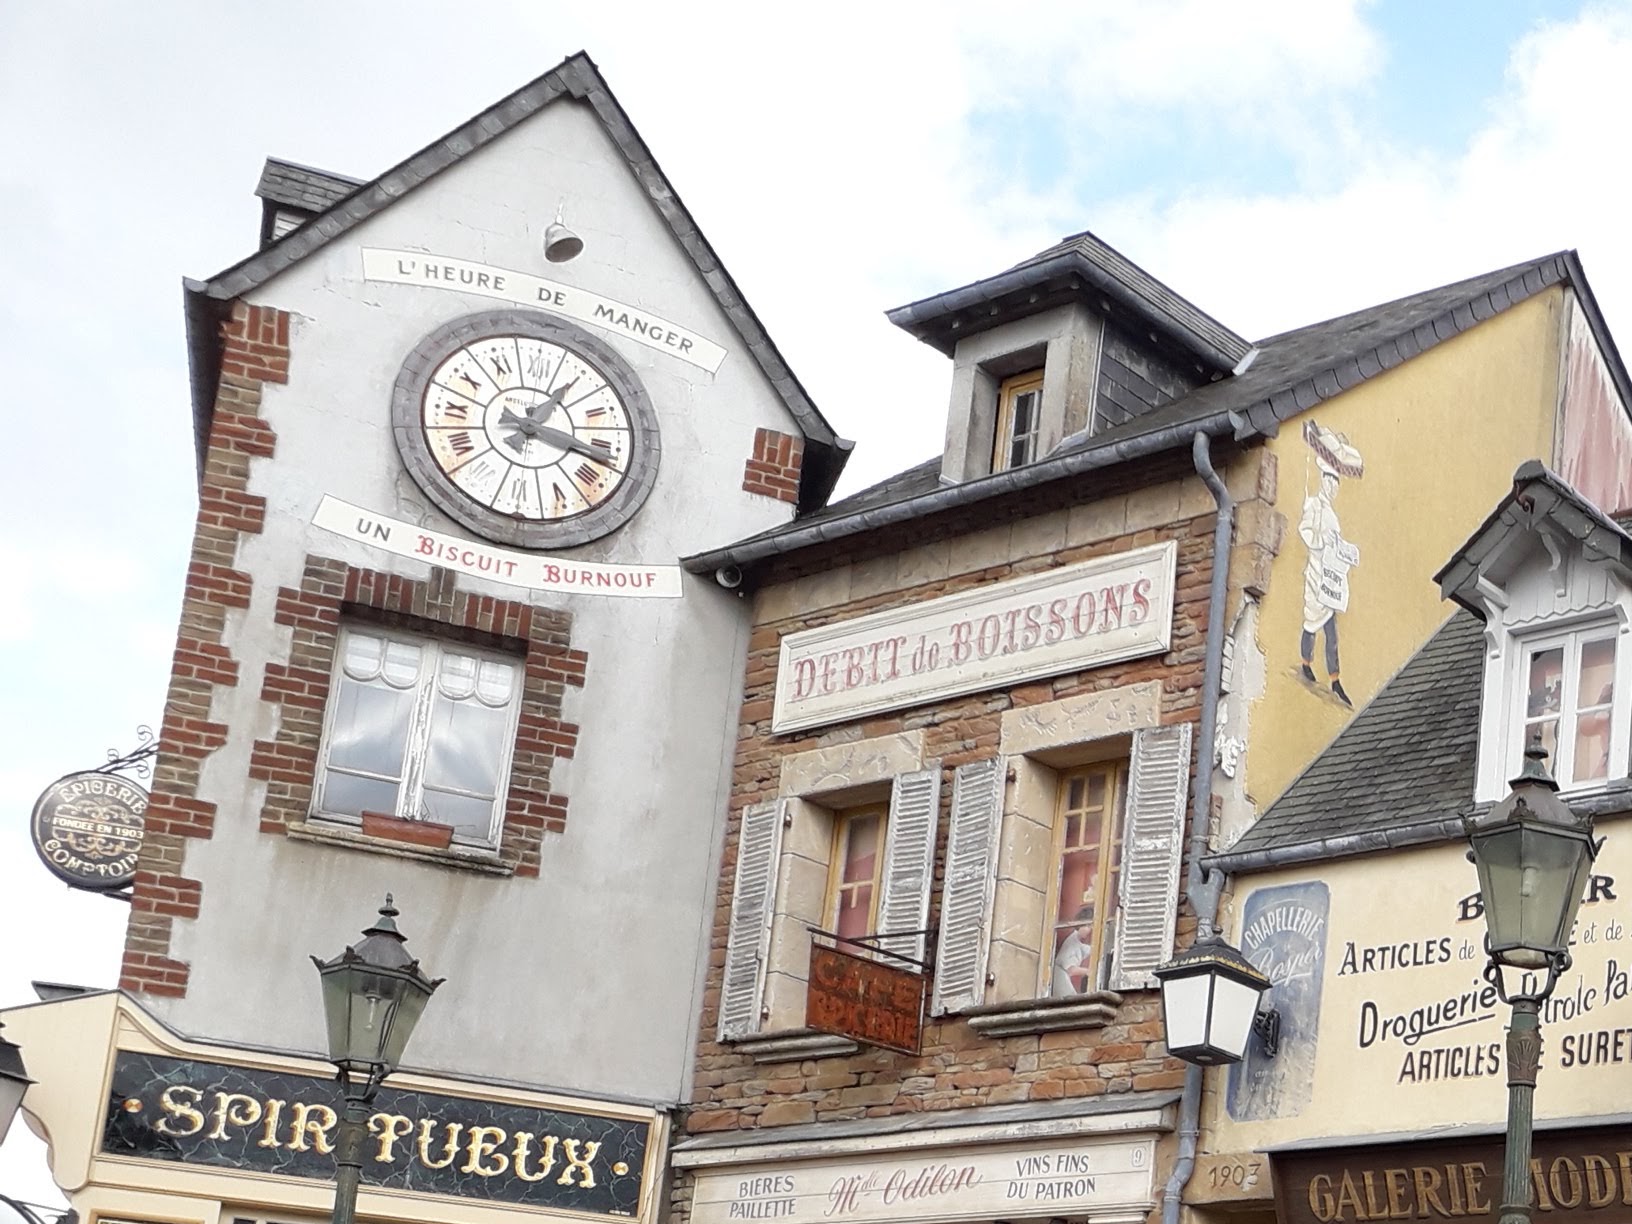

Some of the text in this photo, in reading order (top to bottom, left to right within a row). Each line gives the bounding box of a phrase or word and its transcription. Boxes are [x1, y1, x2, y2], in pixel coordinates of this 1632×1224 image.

[398, 259, 695, 354] L'HEURE DE MANGER
[357, 518, 657, 589] UN BISCUIT BURNOUF
[790, 635, 907, 701] DEBIT
[948, 578, 1152, 667] BOISSONS
[52, 817, 144, 839] FONDEE EN 1903
[1244, 905, 1325, 950] CHAPELLERIE
[1584, 922, 1598, 945] et
[1605, 918, 1623, 942] de
[1337, 937, 1452, 976] ARTICLES
[1459, 939, 1476, 961] de
[1359, 978, 1498, 1046] Droguerie
[1397, 1043, 1502, 1083] ARTICLES
[155, 1085, 603, 1190] SPIRTUEUX
[1133, 1149, 1143, 1165] 9
[884, 1164, 984, 1206] Odilon
[1015, 1154, 1090, 1178] VINS FINS
[729, 1197, 796, 1220] PAILLETTE
[1006, 1178, 1096, 1200] DU PATRON
[1308, 1162, 1492, 1224] GALERIE
